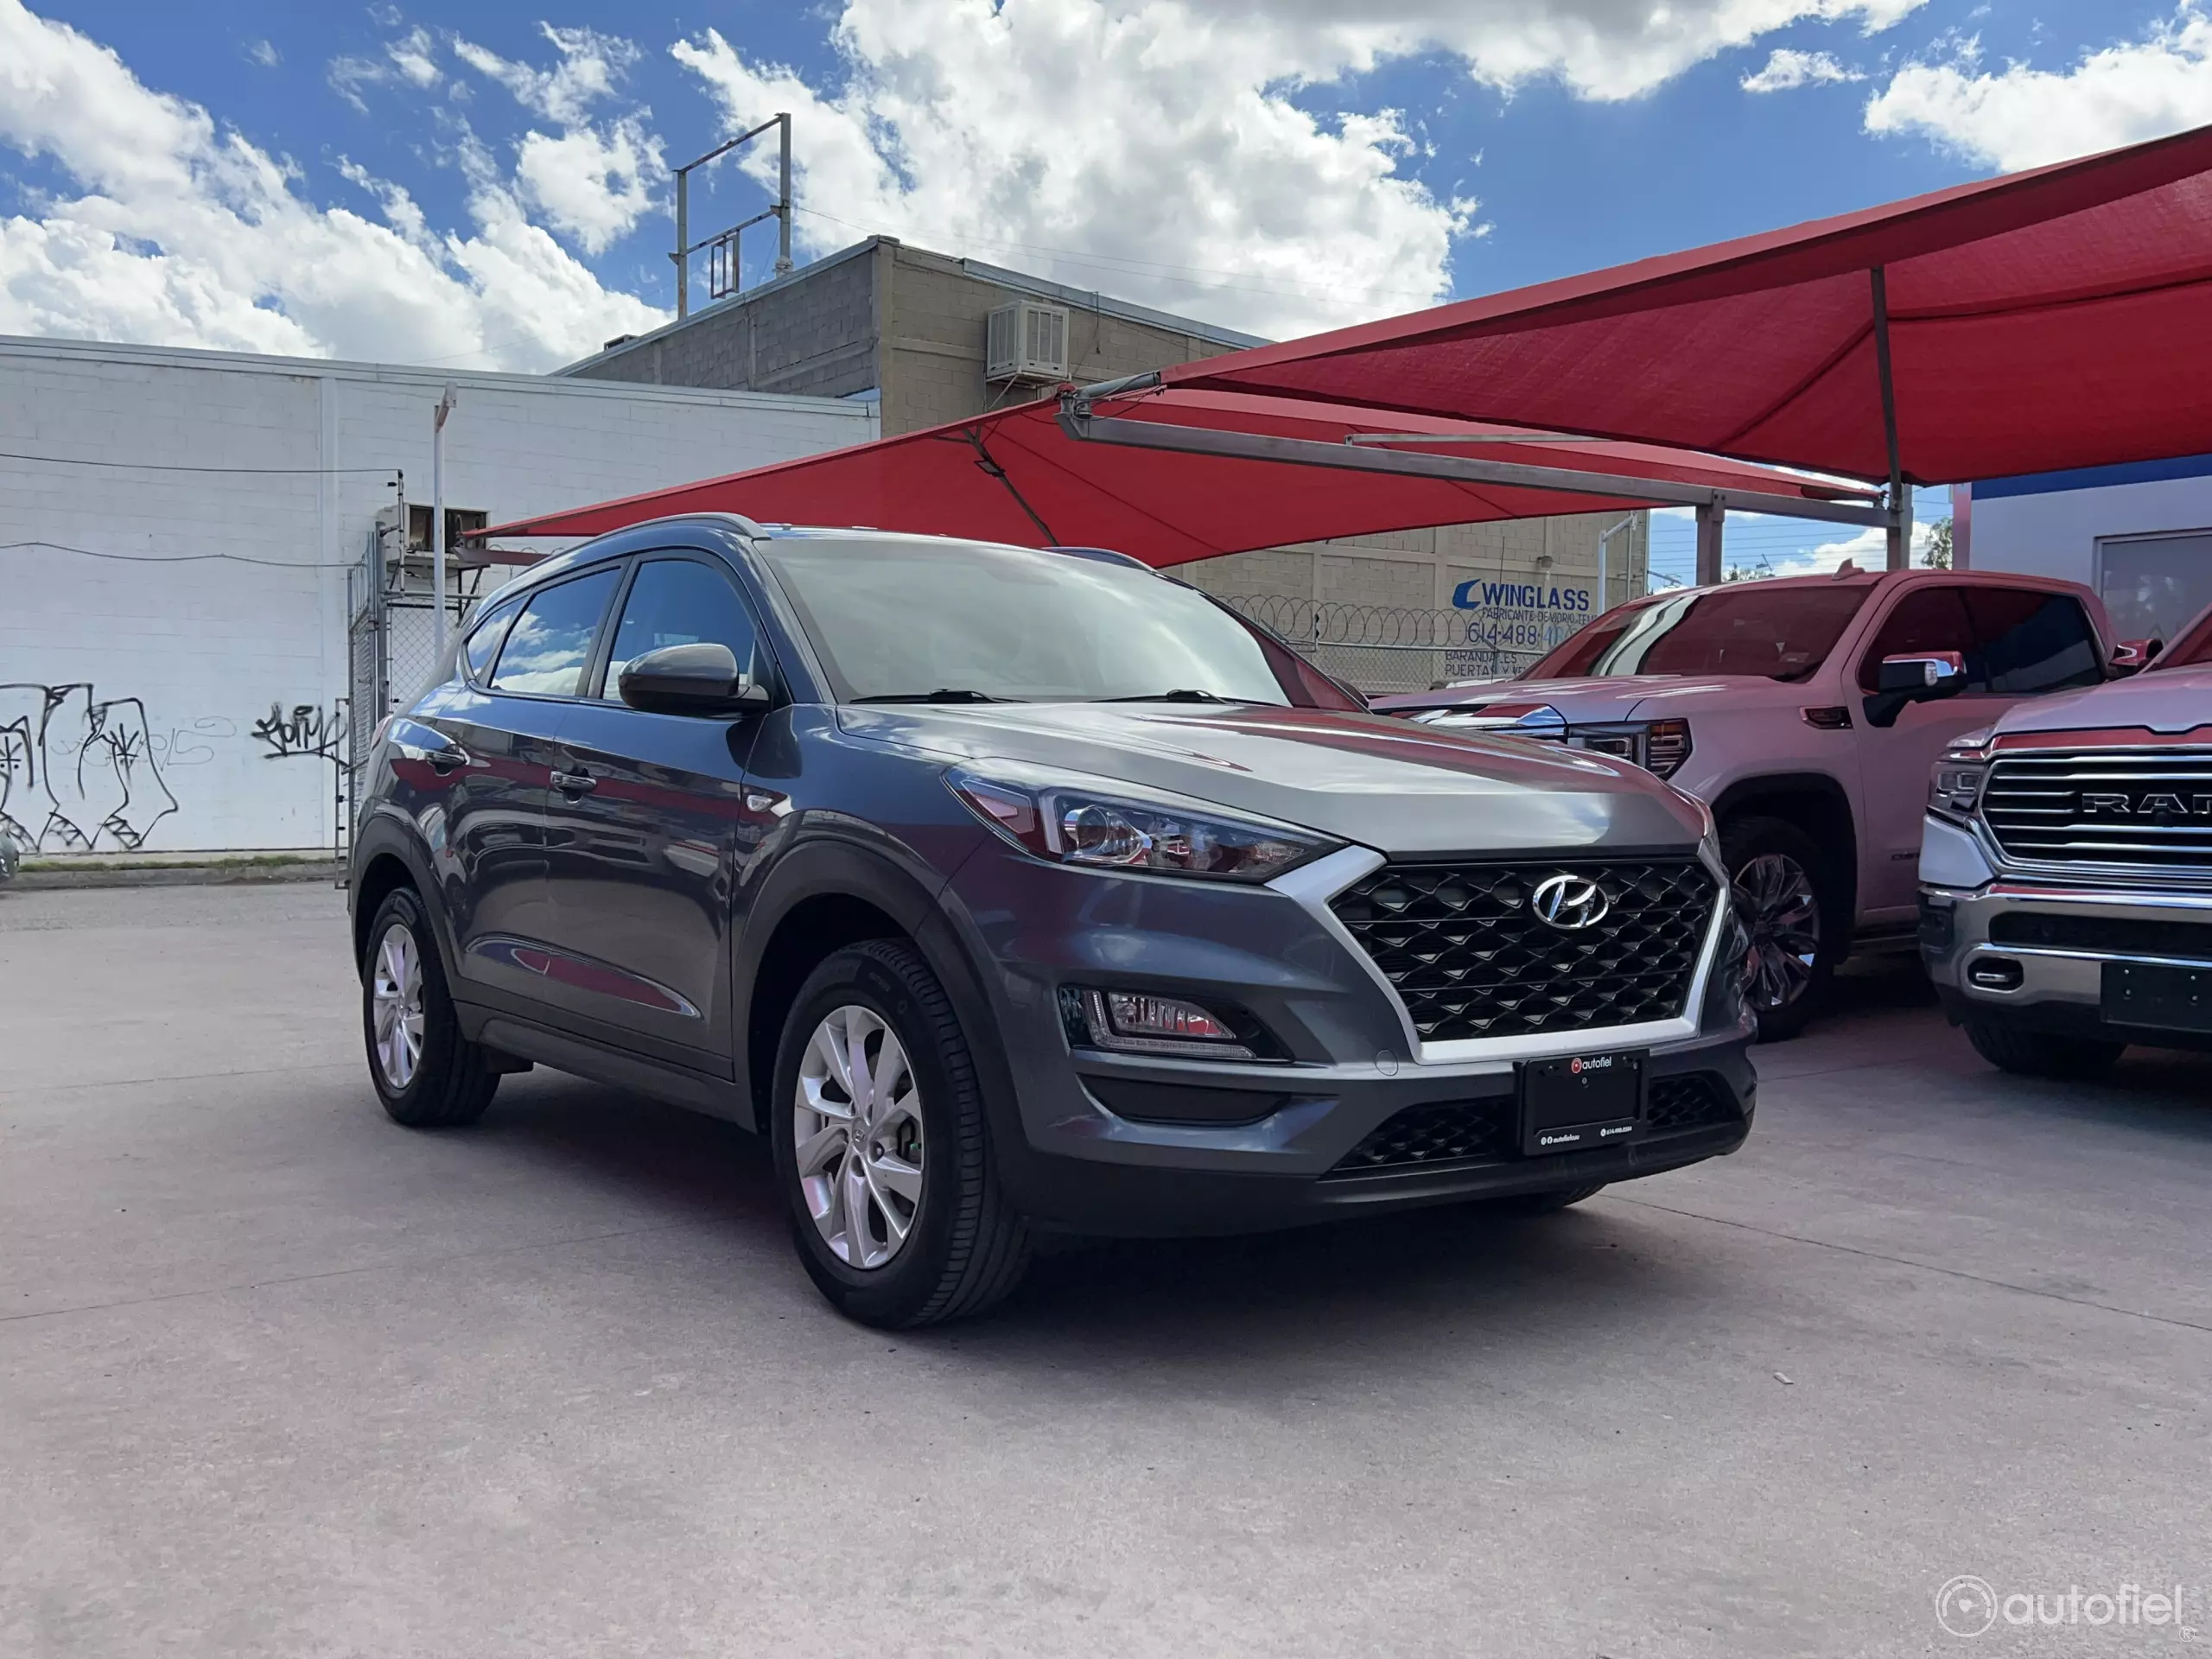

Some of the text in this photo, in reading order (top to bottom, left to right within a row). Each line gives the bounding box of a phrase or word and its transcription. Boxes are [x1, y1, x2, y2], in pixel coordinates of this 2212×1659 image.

[1482, 582, 1589, 611] WINGLASS
[1482, 607, 1535, 622] FABRICANTE
[1537, 611, 1550, 623] DE
[1446, 650, 1517, 664] BARANDAES
[1582, 1056, 1612, 1070] autofiel
